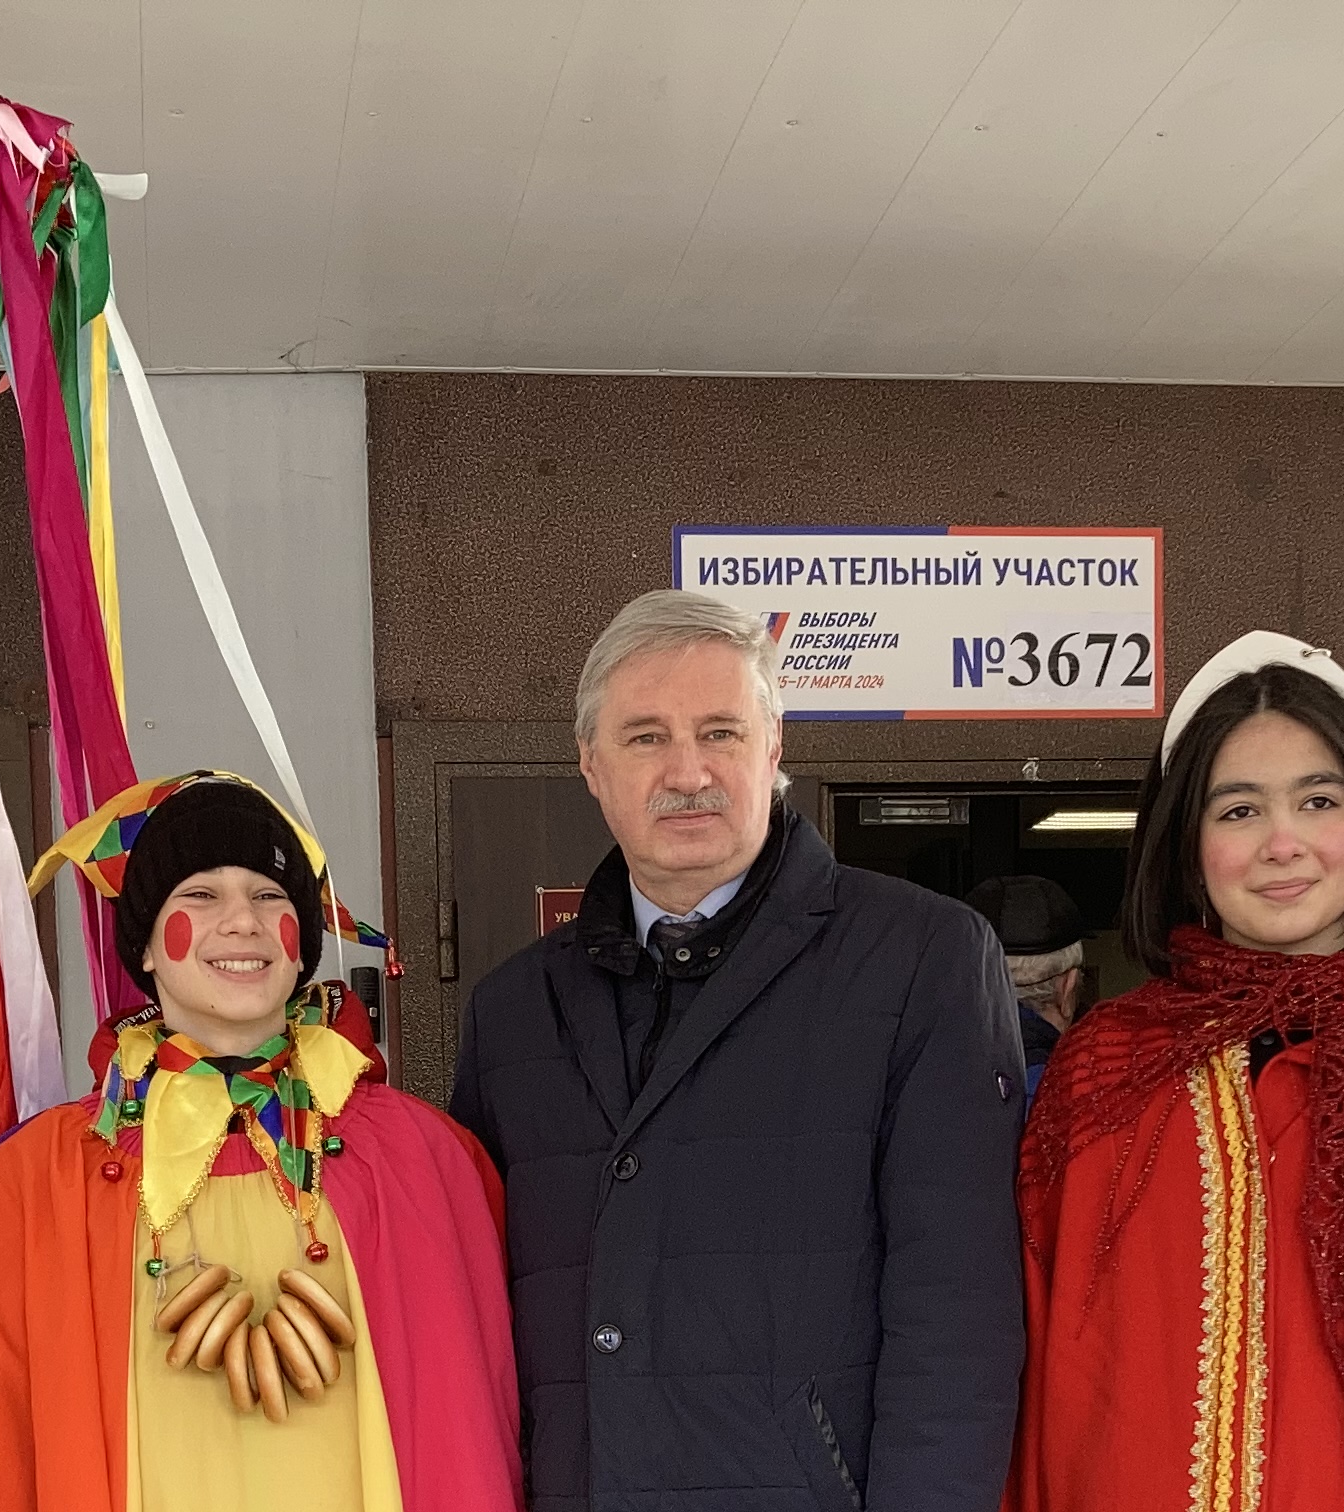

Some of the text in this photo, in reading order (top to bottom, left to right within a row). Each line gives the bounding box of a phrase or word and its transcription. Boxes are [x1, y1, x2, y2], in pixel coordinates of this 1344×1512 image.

[699, 551, 1139, 587] ИЗБИРАТЕЛЬНЫЙ УЧАСТОК
[798, 612, 877, 627] ВЫБОРЫ
[790, 633, 899, 651] ПРЕЗИДЕНТА
[781, 655, 852, 670] РОССИИ
[810, 675, 852, 689] МАРТА
[855, 675, 885, 689] 2024
